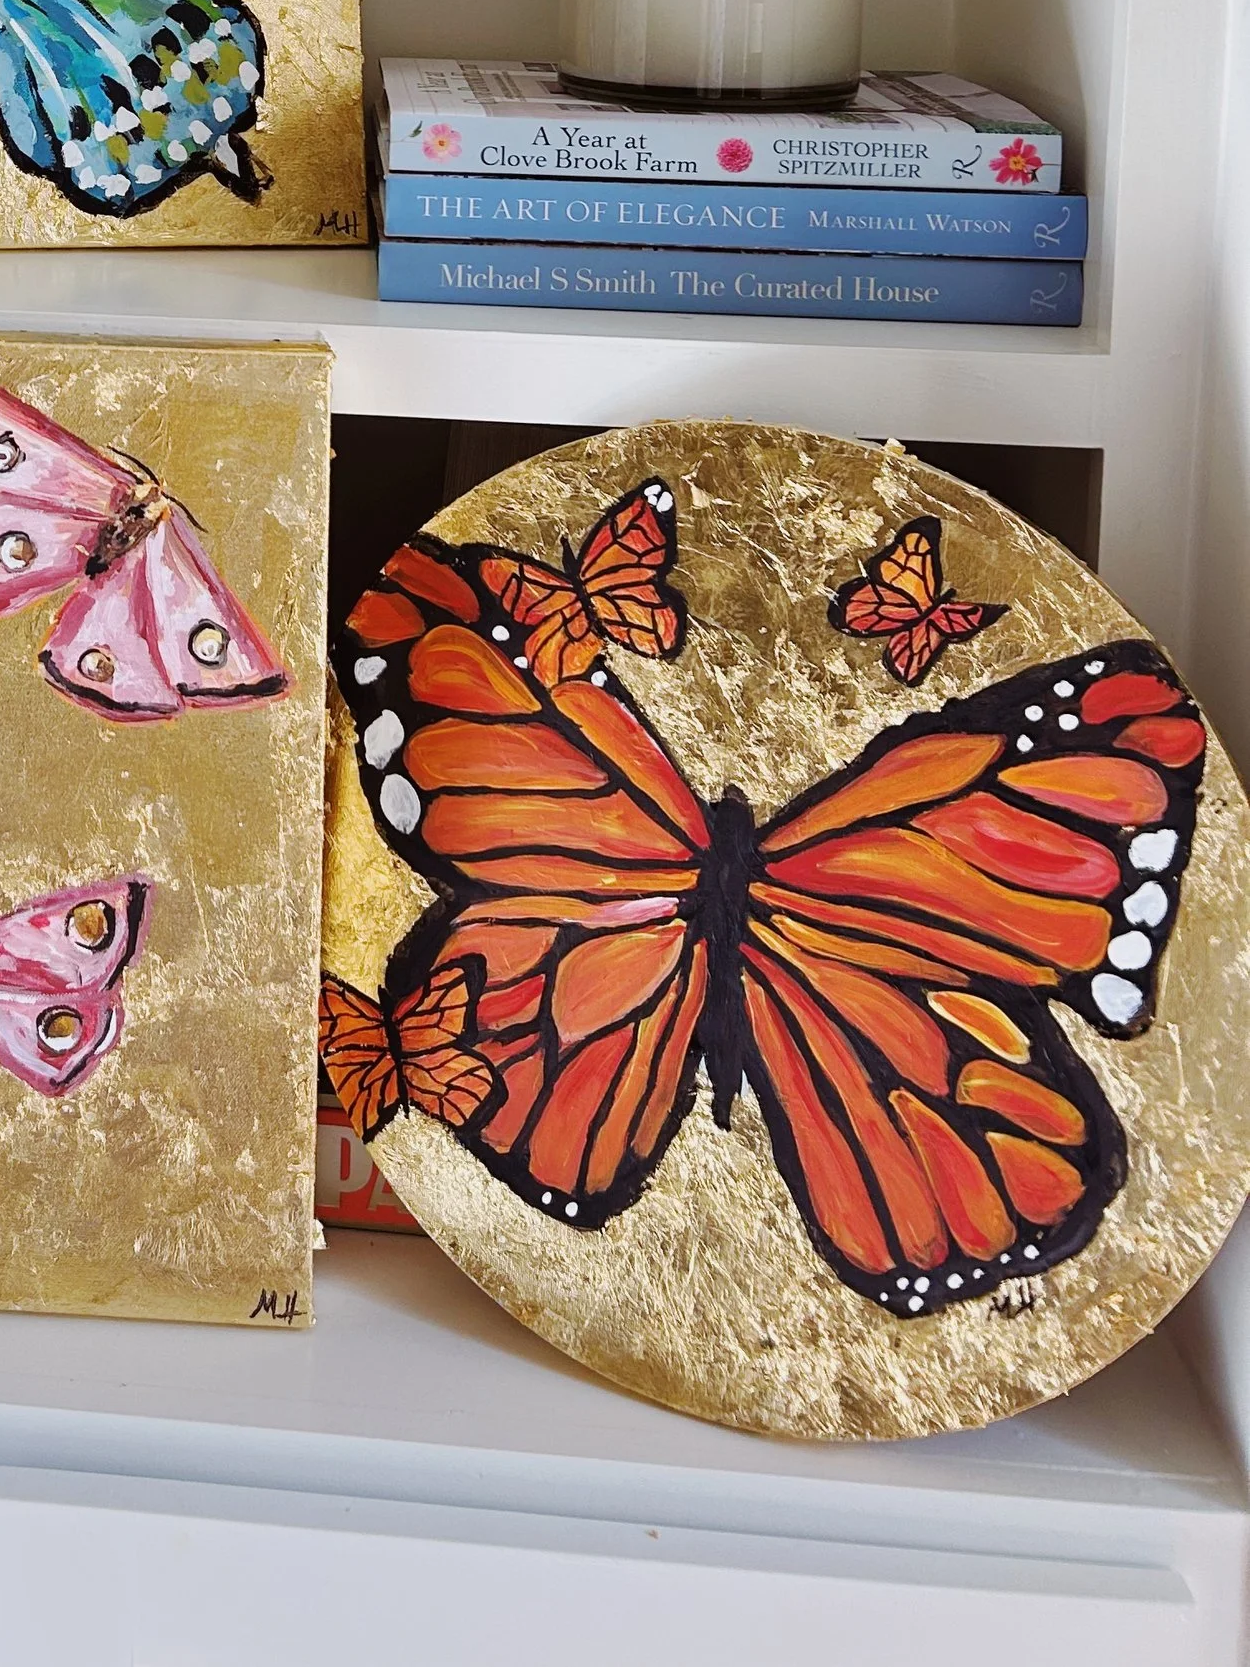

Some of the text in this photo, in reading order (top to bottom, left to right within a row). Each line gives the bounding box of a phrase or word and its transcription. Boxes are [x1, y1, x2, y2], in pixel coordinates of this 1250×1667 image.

[533, 127, 648, 150] A Year at
[773, 139, 930, 160] CHRISTOPHER
[480, 146, 699, 174] Clove Brook Farm
[778, 159, 922, 179] SPITZMILLER
[313, 210, 361, 239] MH
[417, 195, 1012, 234] THE ART OF ELEGANCE MARSHALL WATSON
[439, 263, 940, 304] Michael S Smith The Curated House
